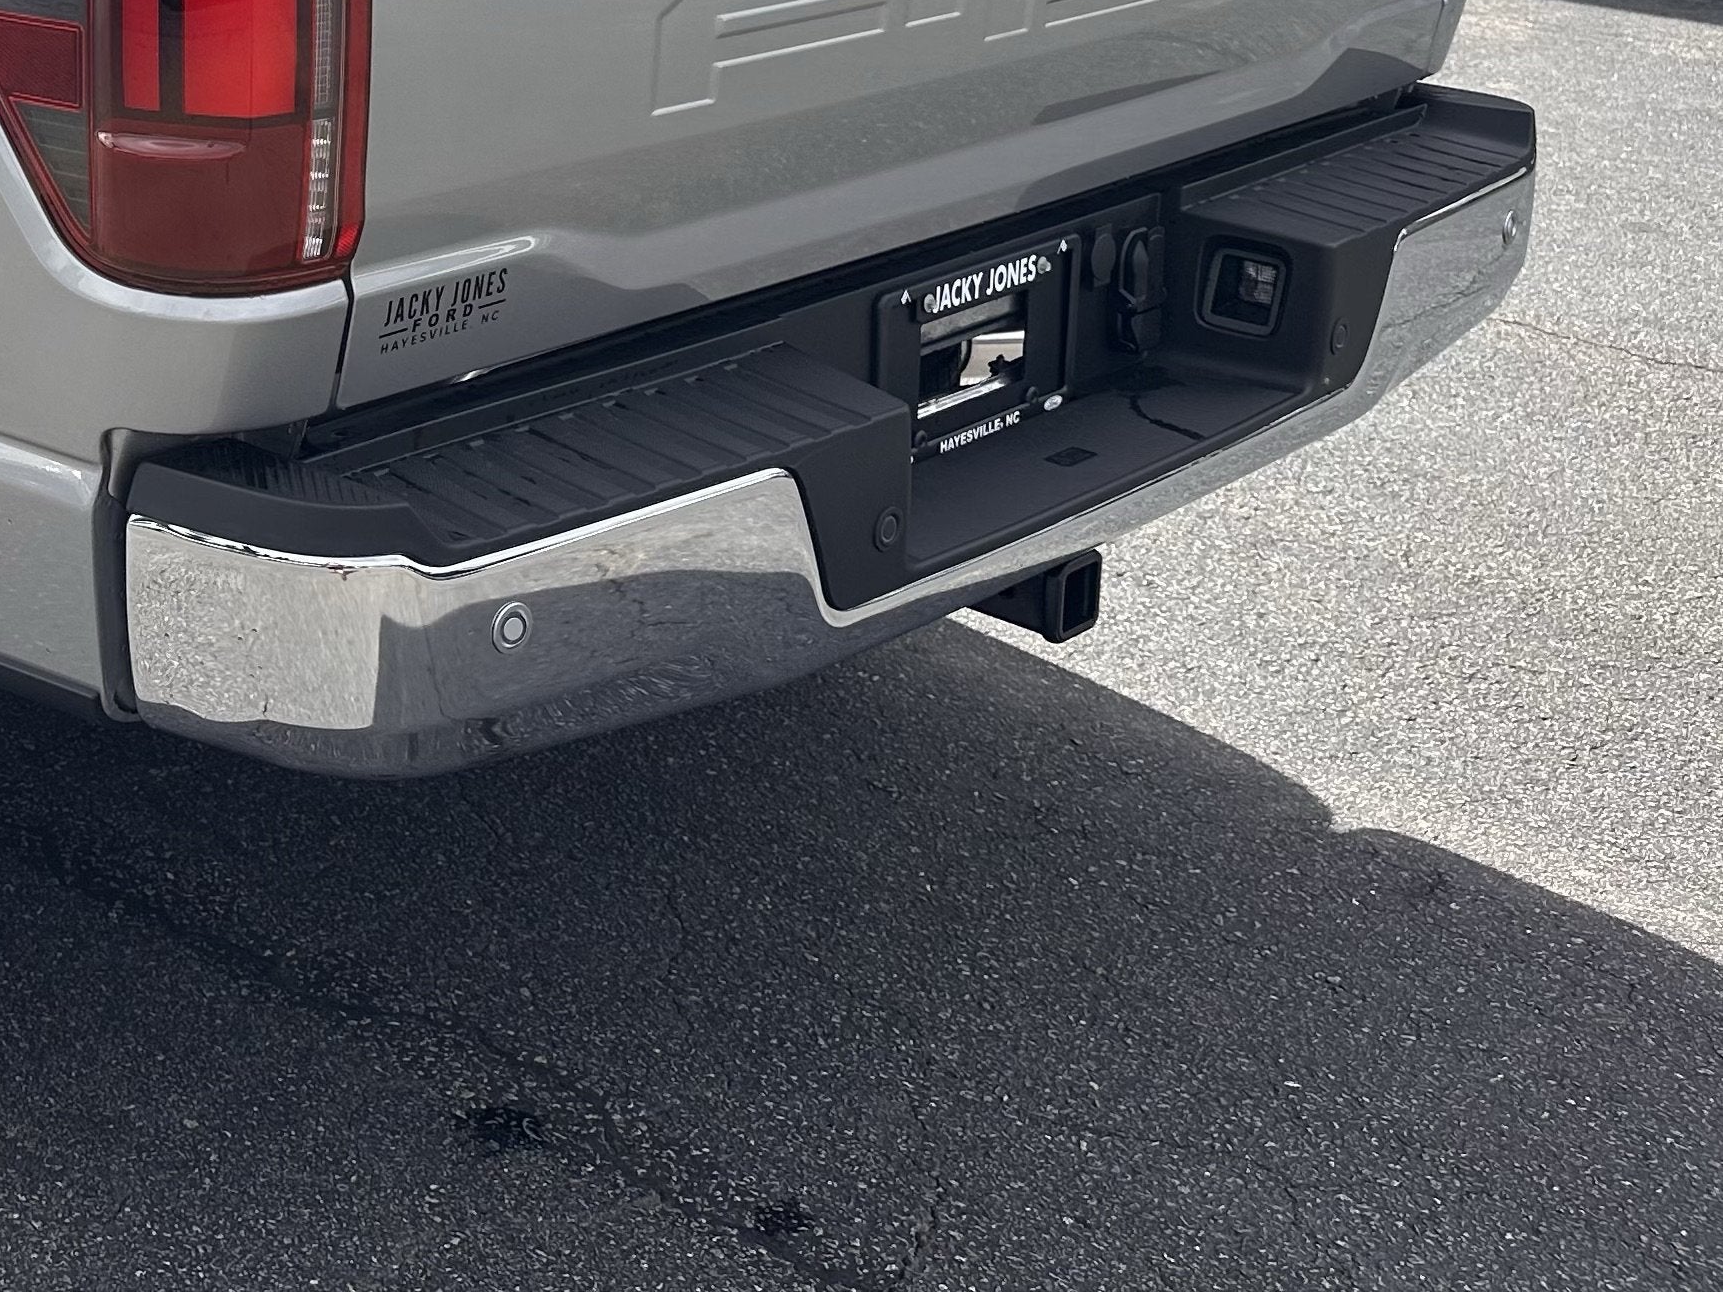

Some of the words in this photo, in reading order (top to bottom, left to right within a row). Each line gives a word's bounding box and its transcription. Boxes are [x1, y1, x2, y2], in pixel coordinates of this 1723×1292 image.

[384, 284, 446, 327] JACKY
[451, 268, 509, 307] JONES
[932, 271, 984, 313] JACKY
[986, 254, 1037, 295] JONES
[412, 303, 473, 332] FORD
[481, 310, 500, 325] NC
[939, 418, 1004, 454] HAYESVILLE,
[1005, 410, 1020, 427] NC
